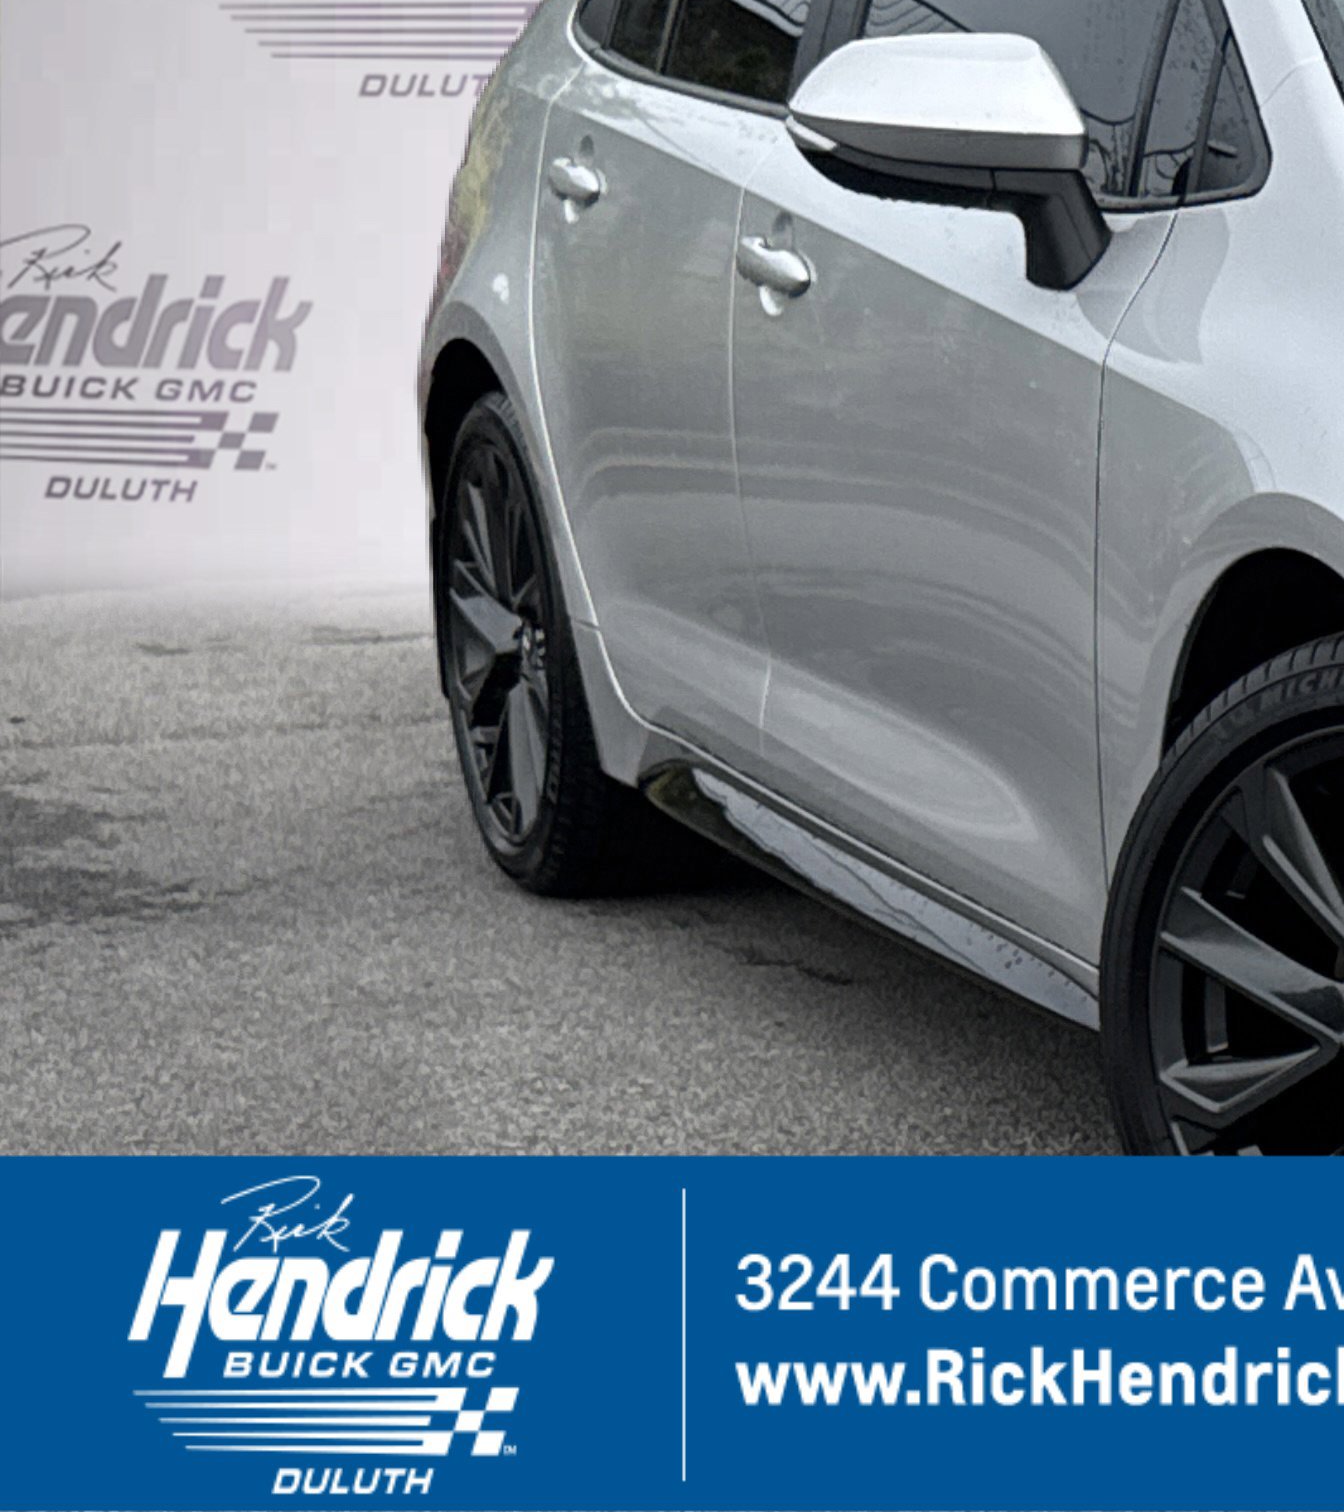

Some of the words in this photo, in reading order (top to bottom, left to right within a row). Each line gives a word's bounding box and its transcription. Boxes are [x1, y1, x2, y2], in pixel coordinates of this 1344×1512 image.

[0, 273, 313, 372] endrick
[0, 374, 138, 400] BUICK
[155, 378, 257, 403] GMC
[44, 476, 197, 503] DULUTH
